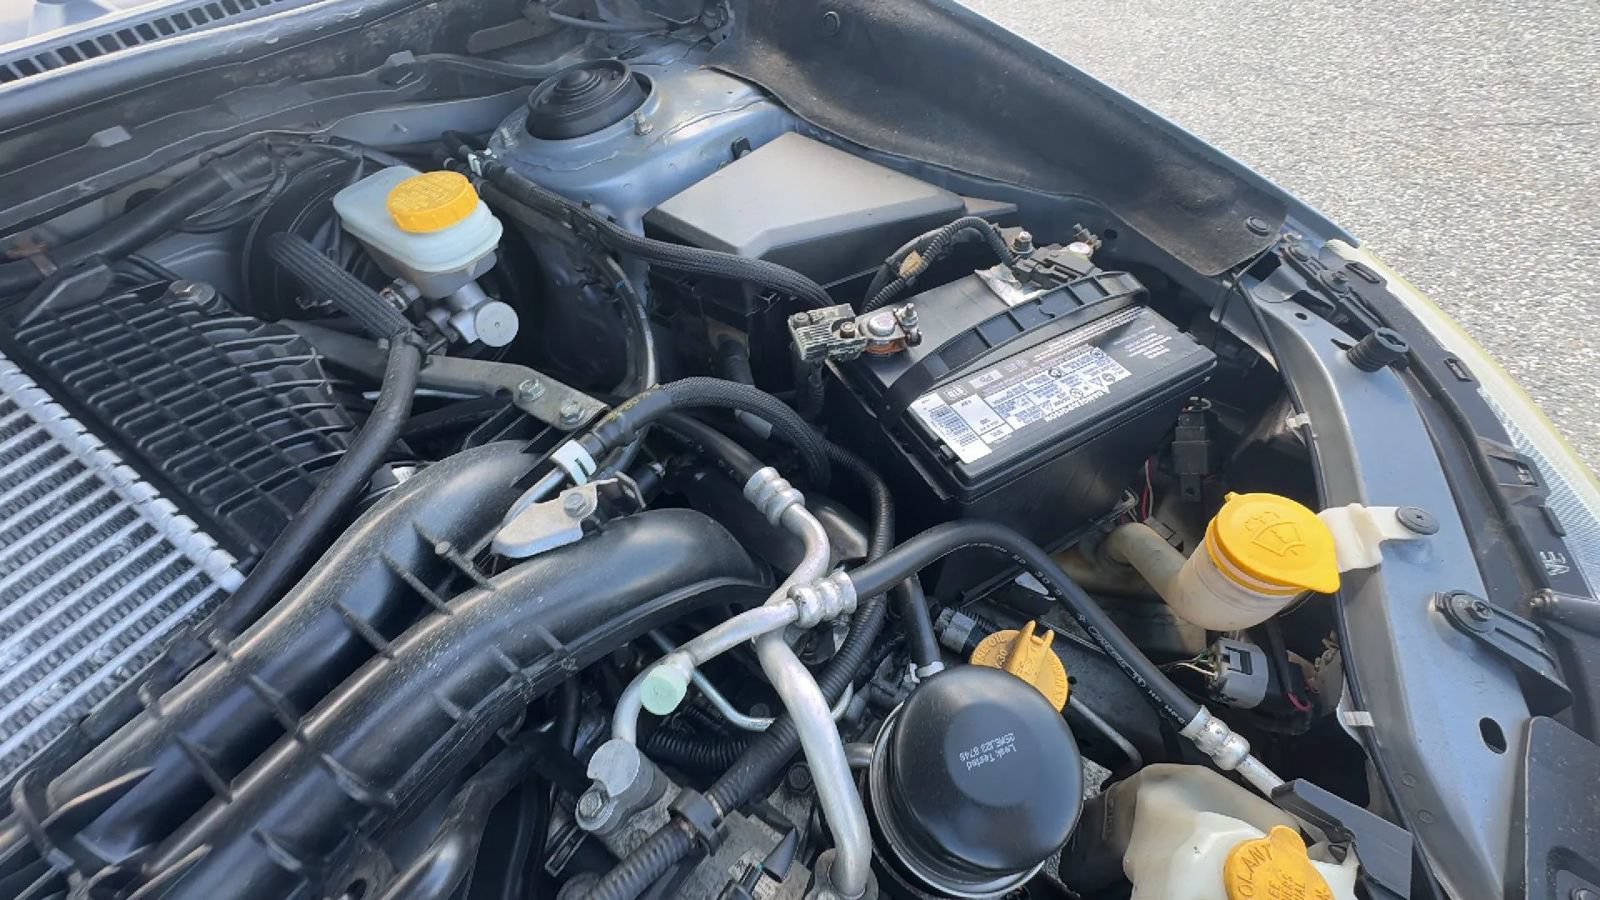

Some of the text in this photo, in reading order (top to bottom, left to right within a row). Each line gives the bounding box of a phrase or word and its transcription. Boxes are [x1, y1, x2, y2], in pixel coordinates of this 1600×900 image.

[988, 633, 1007, 647] OIL
[966, 743, 1017, 771] Leak Tested
[1237, 844, 1273, 897] OLANT
